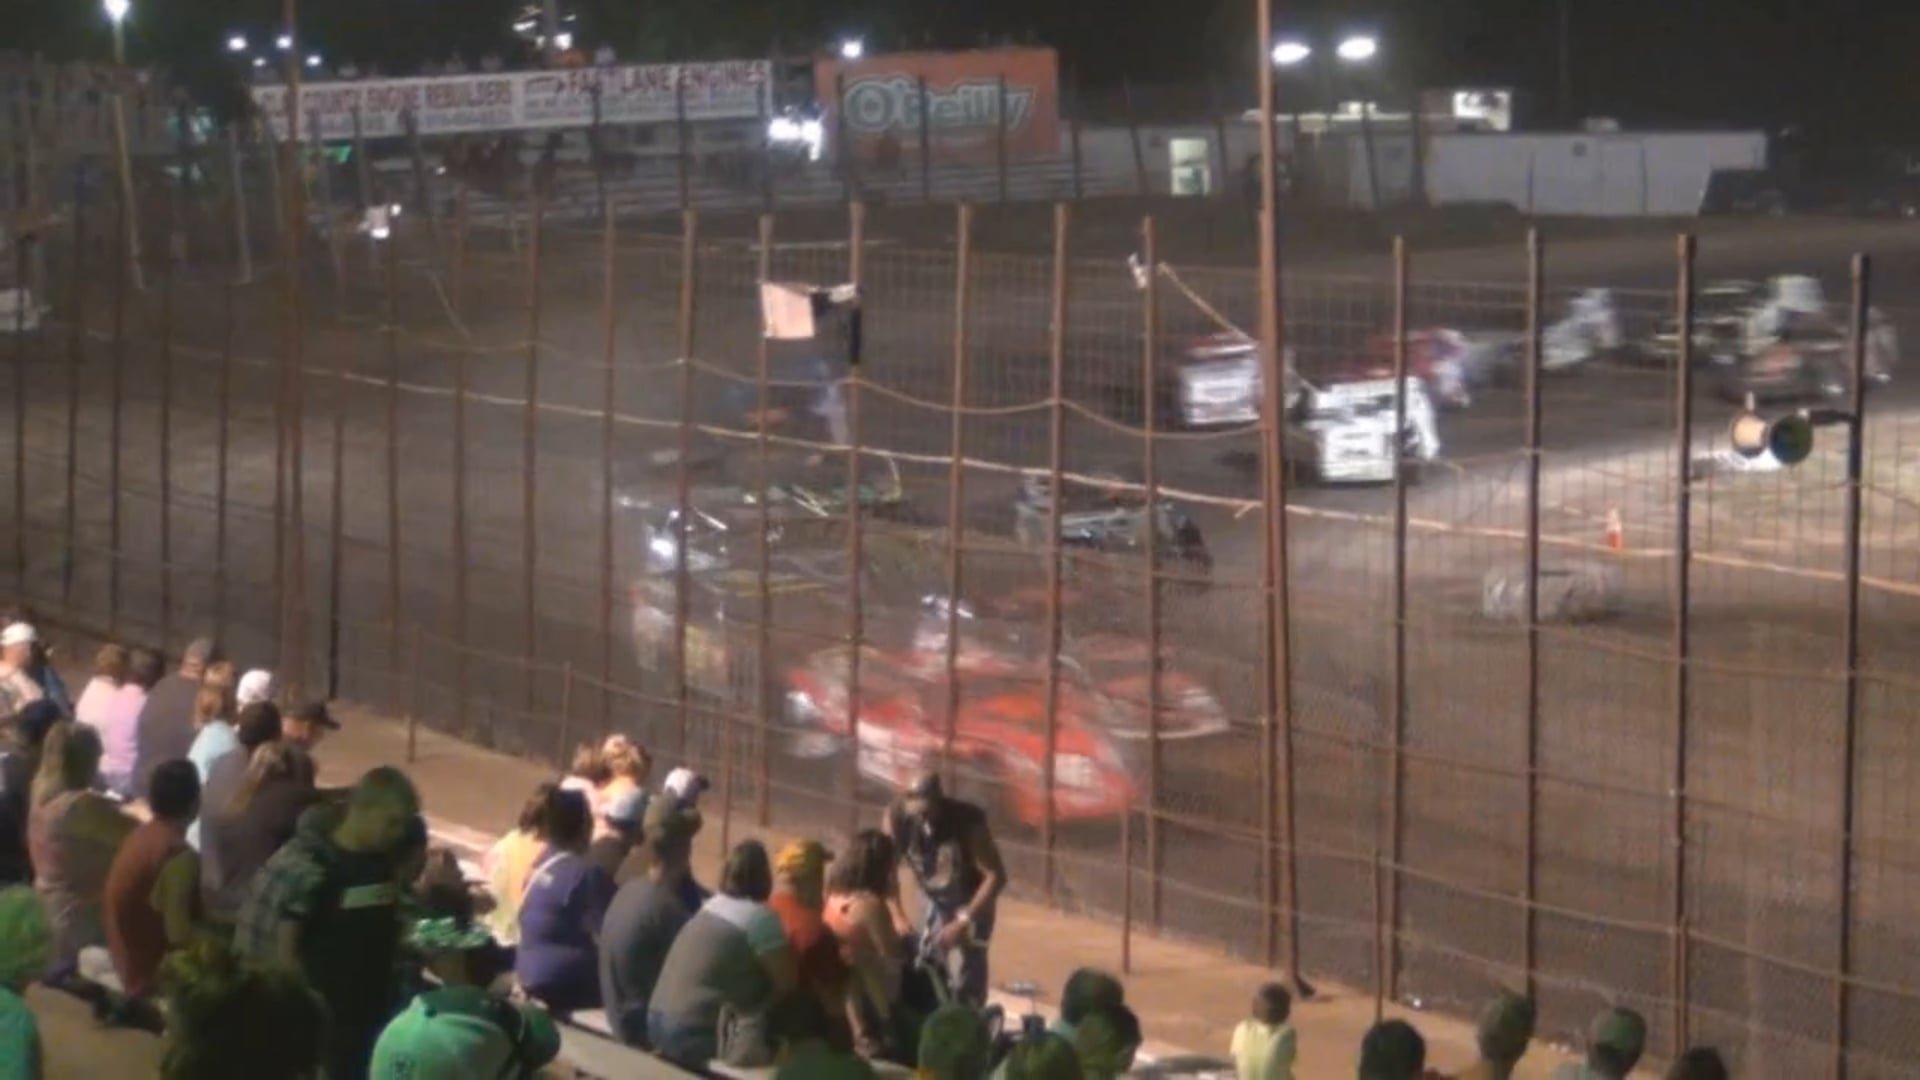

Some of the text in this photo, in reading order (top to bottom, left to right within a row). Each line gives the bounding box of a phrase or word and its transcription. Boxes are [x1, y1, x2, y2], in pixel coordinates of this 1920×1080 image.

[620, 64, 672, 92] LANE
[677, 60, 767, 90] ENGINES
[366, 84, 420, 113] ENGINE
[425, 79, 512, 110] REBUILDERS
